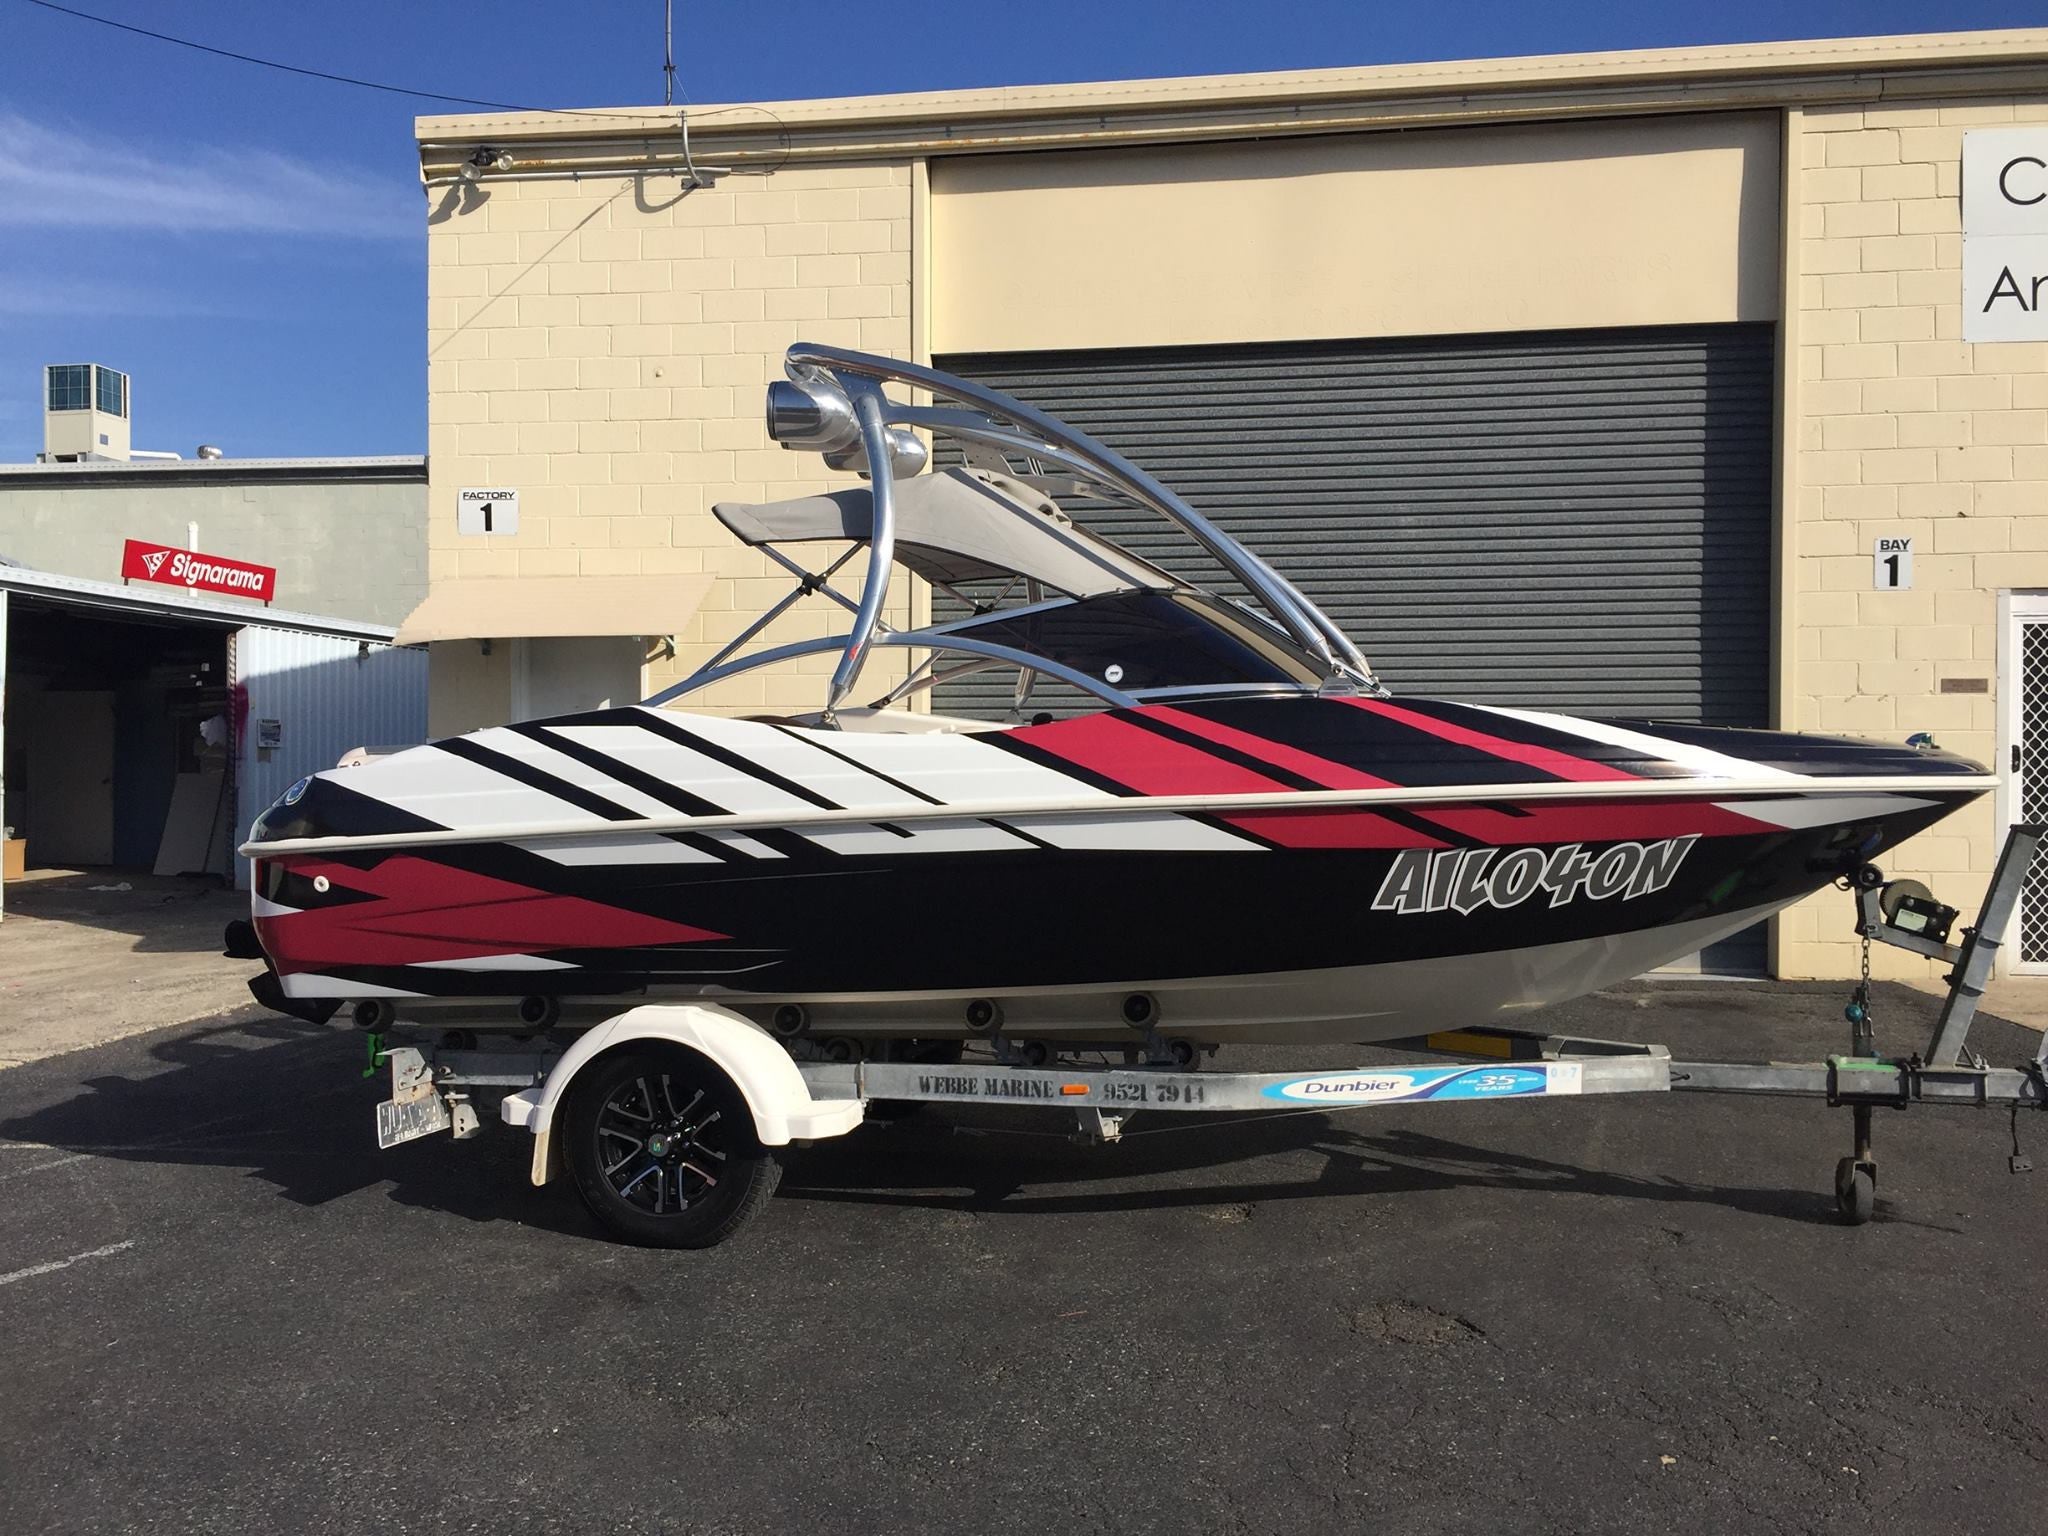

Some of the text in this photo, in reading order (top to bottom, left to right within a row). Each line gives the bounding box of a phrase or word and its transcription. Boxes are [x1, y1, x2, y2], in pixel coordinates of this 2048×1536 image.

[462, 491, 516, 500] FACTORY
[480, 502, 493, 532] 1
[1880, 537, 1912, 551] BAY
[170, 553, 265, 591] Signarama
[1883, 554, 1899, 587] 1
[918, 1075, 978, 1095] WEBBE
[984, 1078, 1054, 1098] MARINE
[1103, 1083, 1148, 1102] 9521
[1304, 1080, 1400, 1094] Dunbier
[1476, 1074, 1517, 1087] 35
